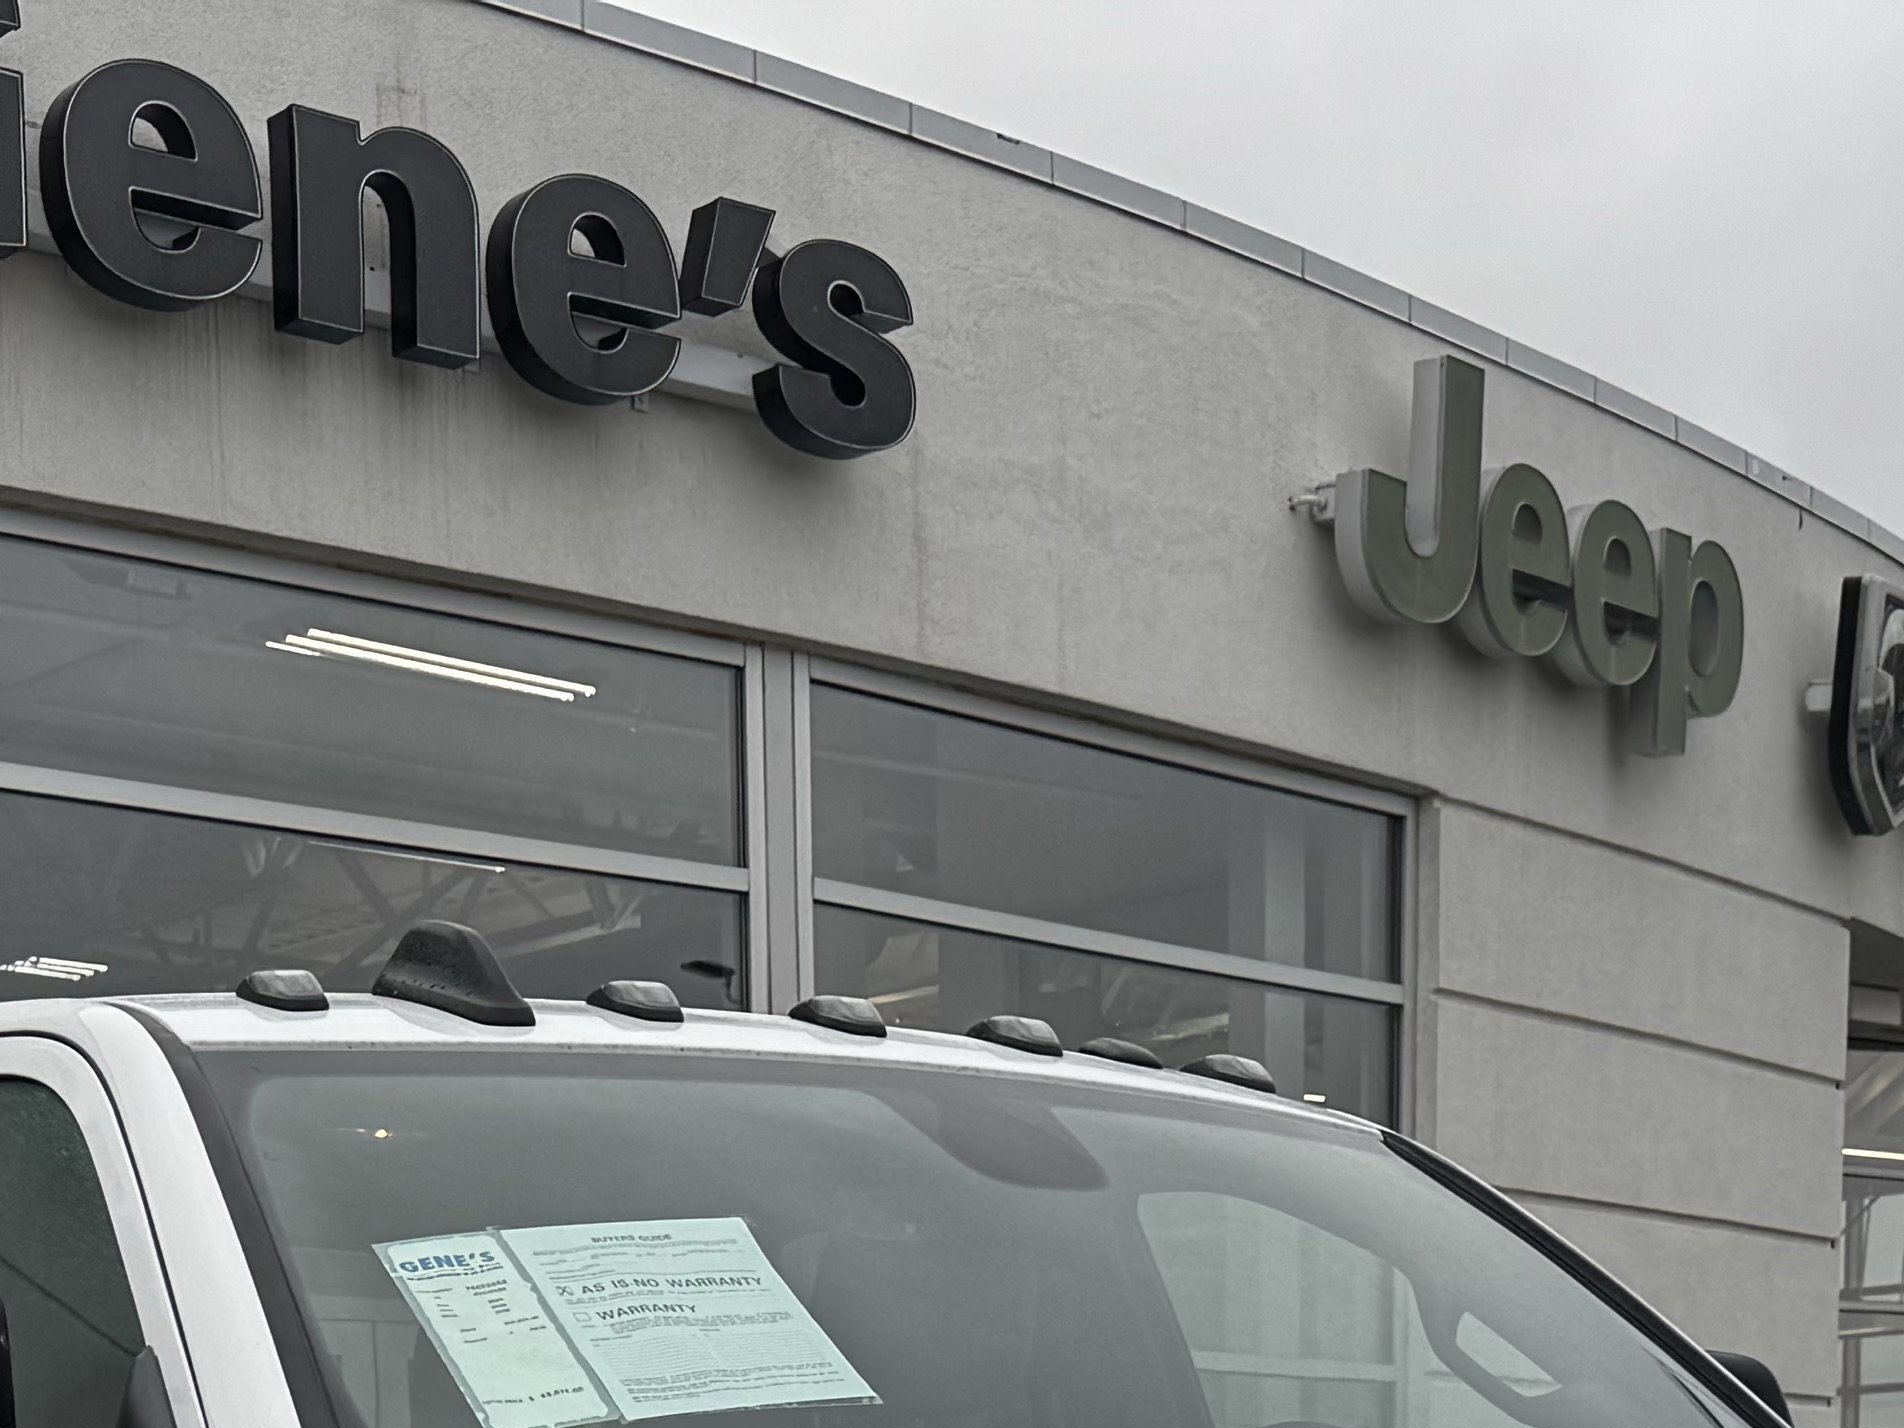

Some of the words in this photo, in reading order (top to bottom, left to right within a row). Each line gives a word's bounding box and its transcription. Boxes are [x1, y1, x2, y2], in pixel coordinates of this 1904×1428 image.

[1334, 354, 1744, 757] Jeep
[398, 1251, 496, 1273] GENE'S
[581, 1282, 606, 1295] AS
[665, 1275, 763, 1288] WARRANTY
[596, 1303, 697, 1321] WARRANTY
